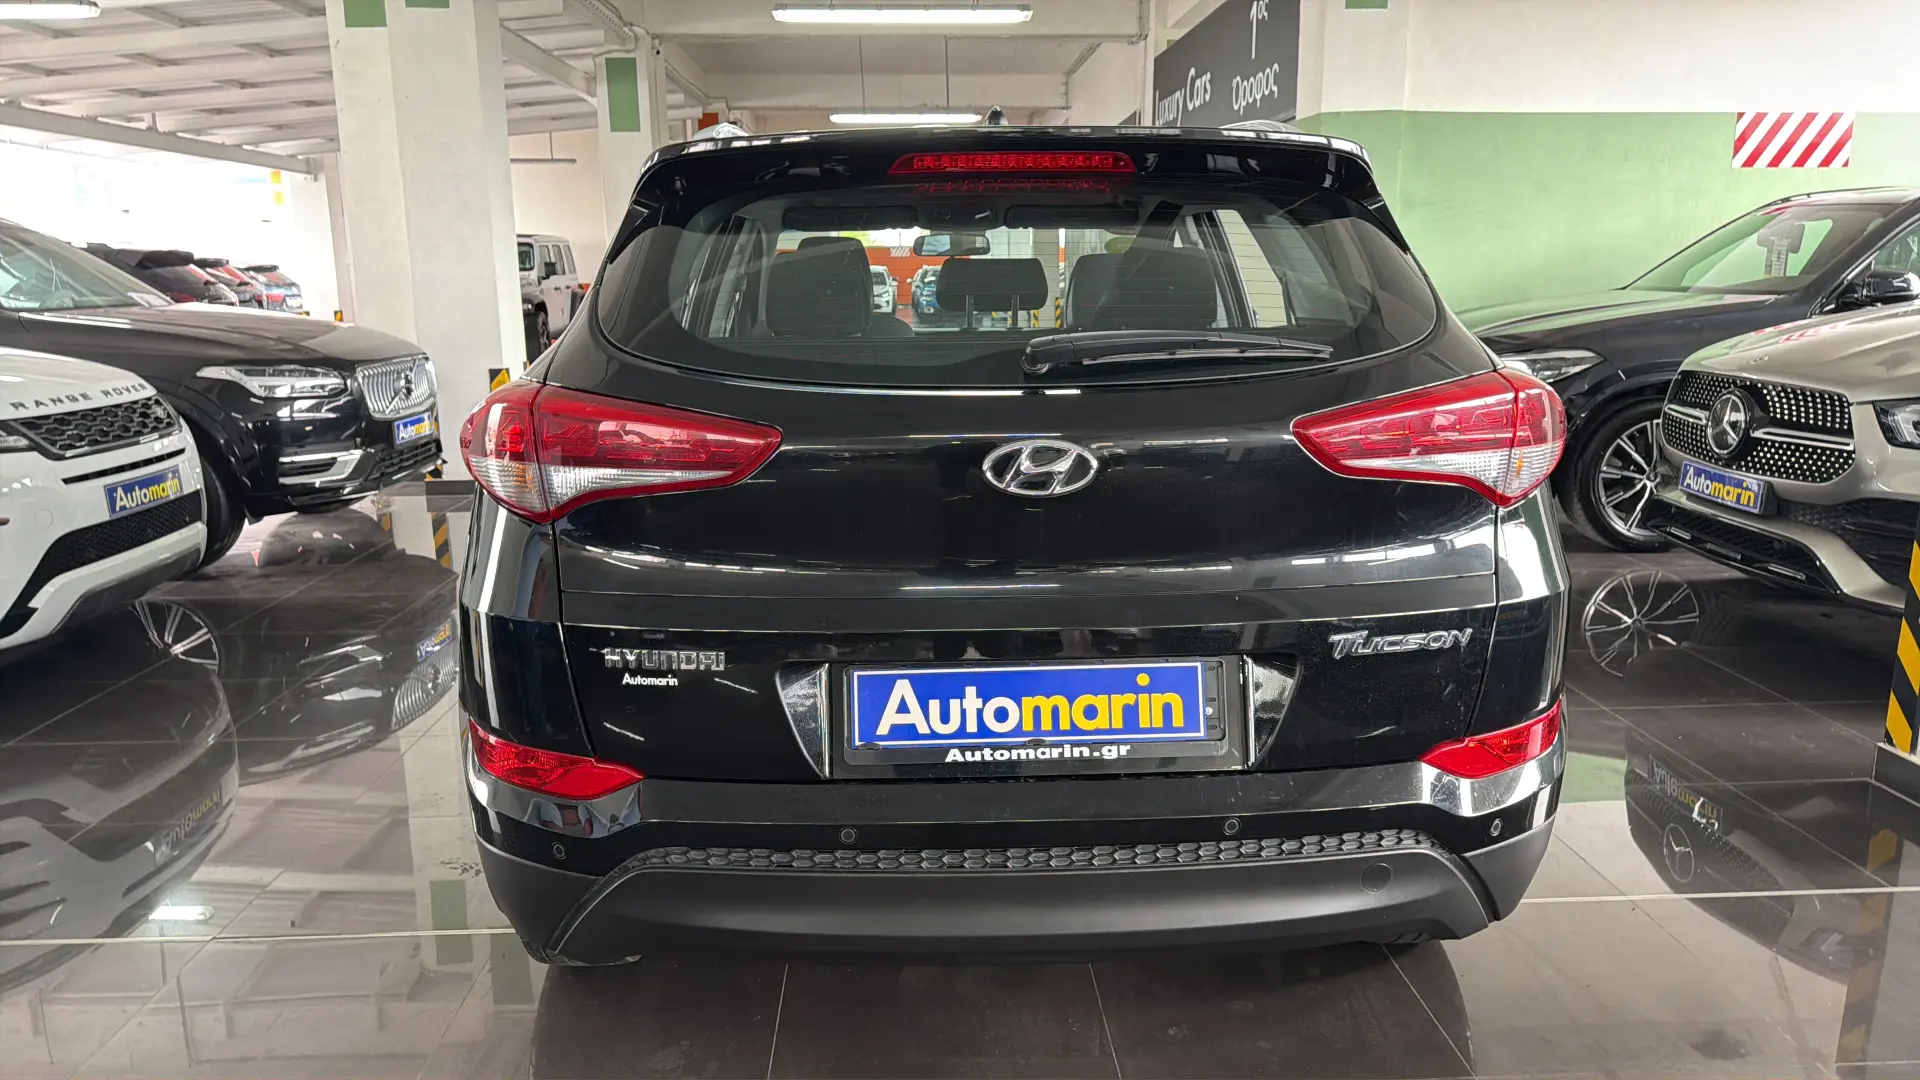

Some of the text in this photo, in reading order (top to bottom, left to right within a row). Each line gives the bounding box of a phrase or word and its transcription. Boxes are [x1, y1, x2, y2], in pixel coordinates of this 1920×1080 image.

[1155, 66, 1211, 127] Luxury Cars
[9, 382, 148, 411] RANGE ROVER
[114, 472, 180, 512] Automarin
[1683, 465, 1755, 508] Automarin
[603, 647, 725, 671] HYUNDAI
[621, 672, 679, 687] Automarin
[875, 673, 1184, 735] Automarin
[944, 743, 1131, 763] Automarin.gr
